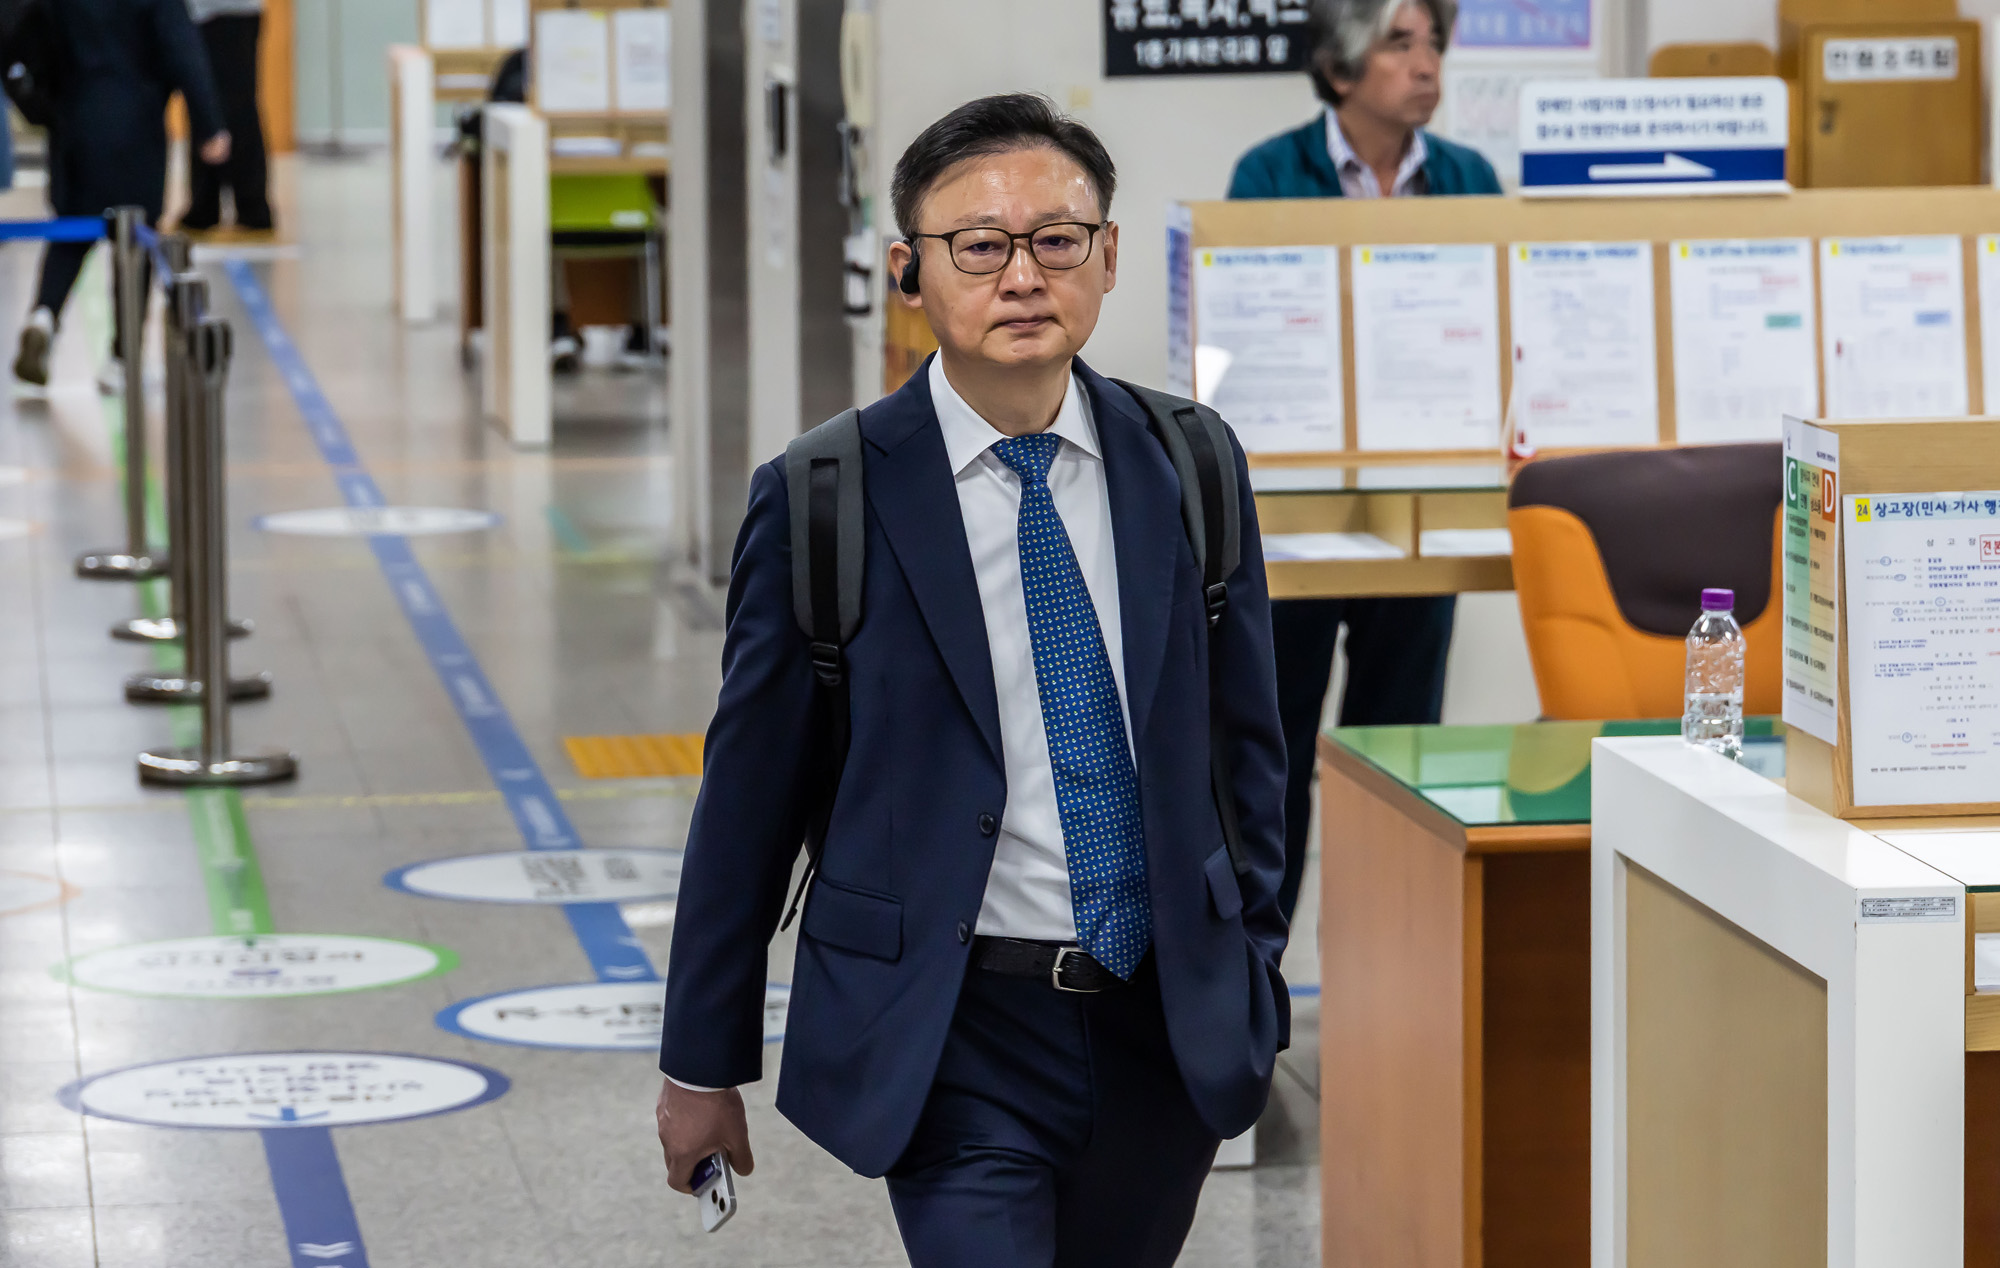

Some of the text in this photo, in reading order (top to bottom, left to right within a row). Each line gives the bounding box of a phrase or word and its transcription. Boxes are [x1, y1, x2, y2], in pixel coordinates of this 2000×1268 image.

[1788, 461, 1797, 501] C
[1824, 473, 1834, 513] D
[1857, 504, 1868, 516] 24
